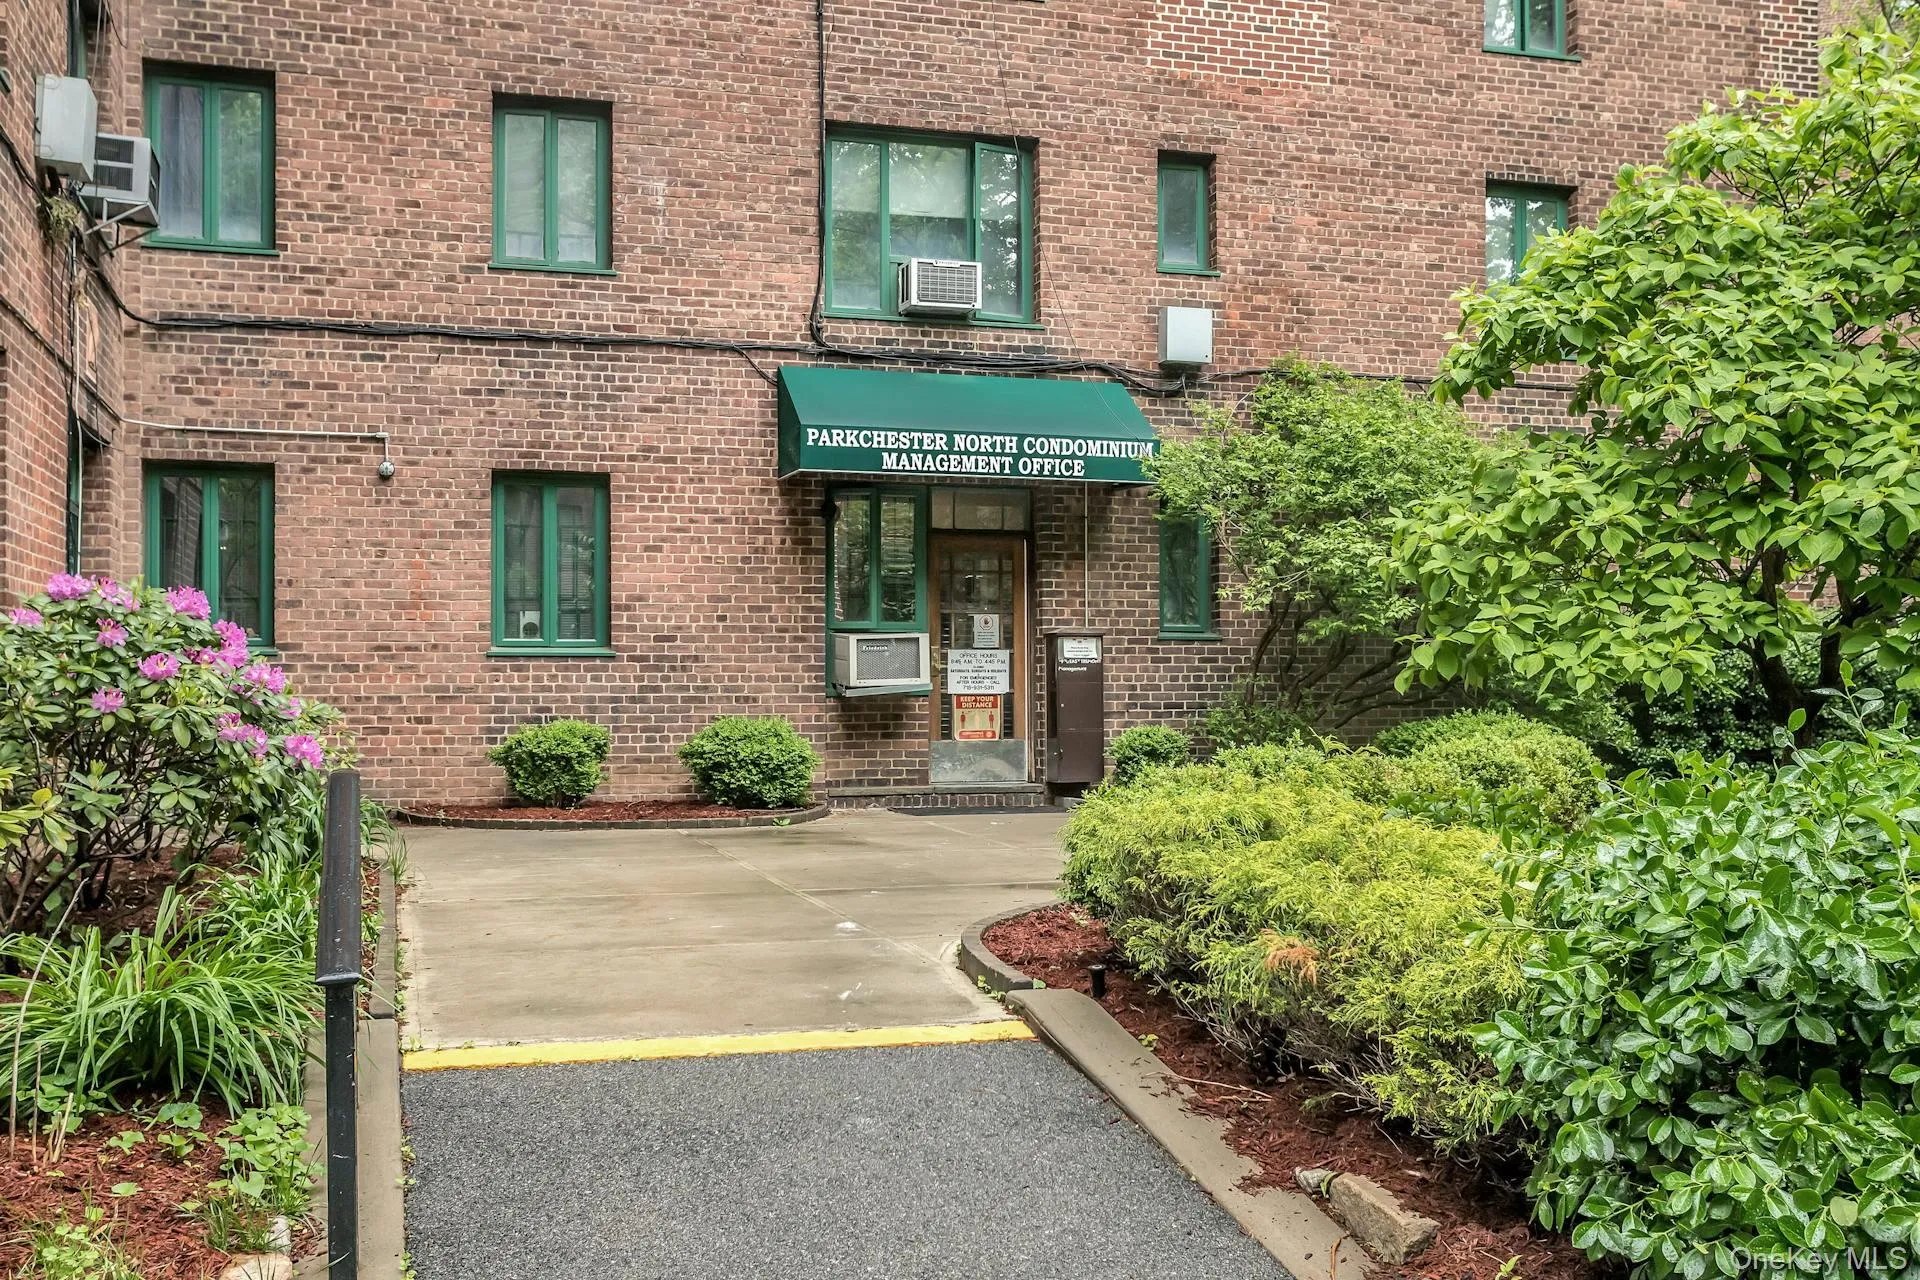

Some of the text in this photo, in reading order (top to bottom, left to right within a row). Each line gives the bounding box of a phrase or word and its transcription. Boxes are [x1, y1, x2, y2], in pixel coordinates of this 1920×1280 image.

[806, 427, 1154, 459] PARKCHESTER NORTH CONDOMINIUM
[881, 451, 1085, 476] MANAGEMENT OFFICE
